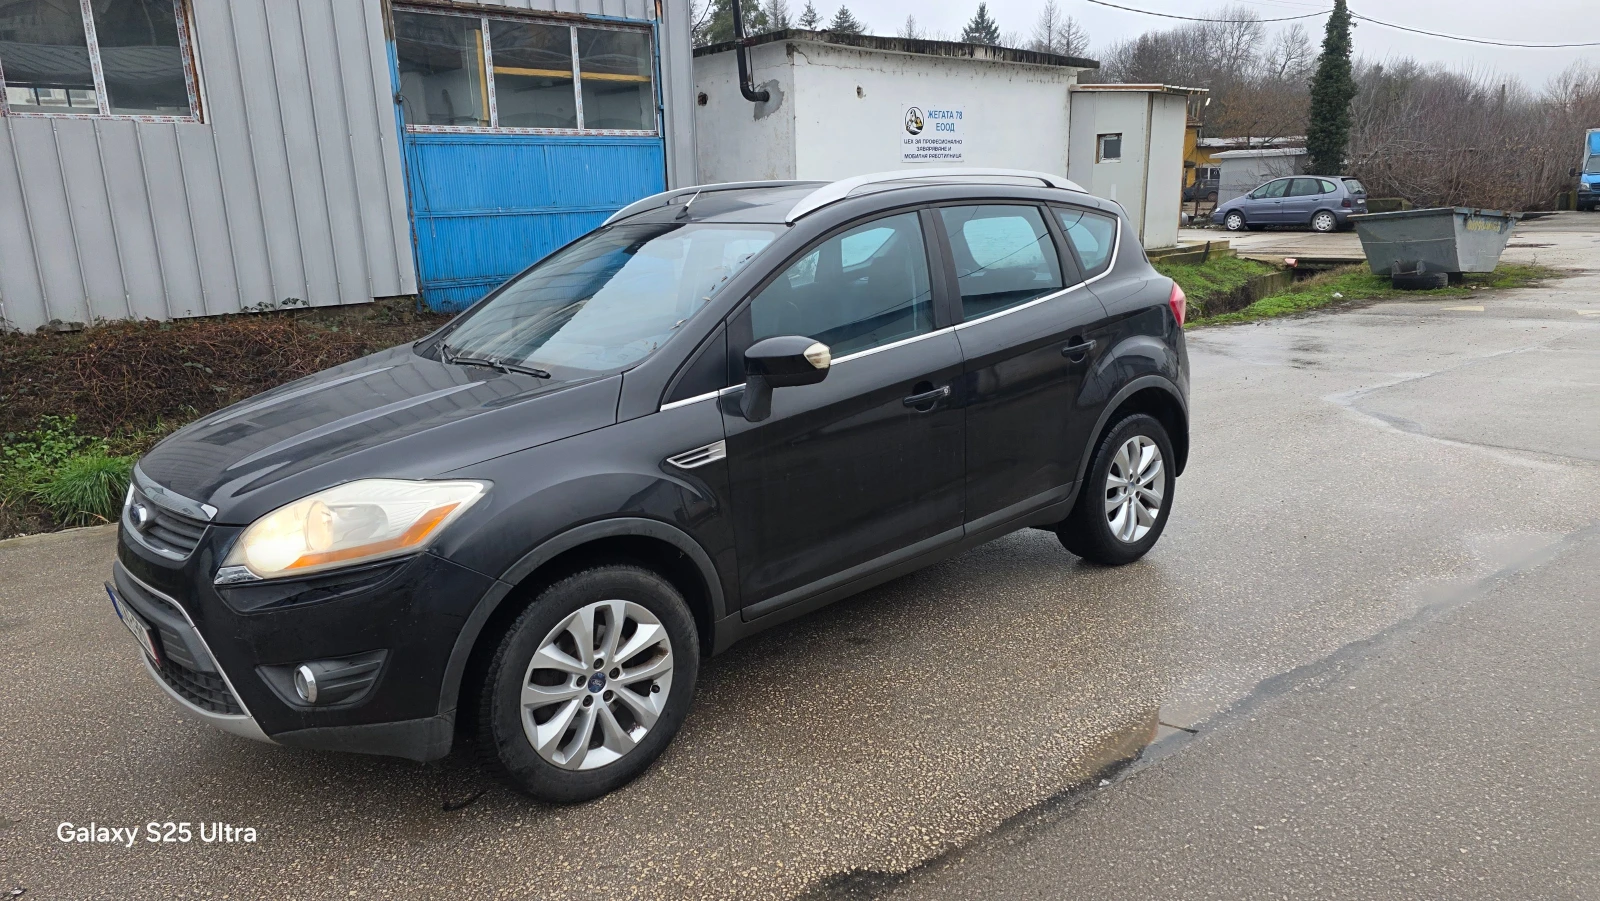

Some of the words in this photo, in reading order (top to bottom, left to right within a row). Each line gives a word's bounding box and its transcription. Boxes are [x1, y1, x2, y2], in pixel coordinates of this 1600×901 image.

[928, 110, 954, 119] ЖЕГАТА
[955, 111, 963, 120] 78
[936, 122, 955, 132] ЕООД
